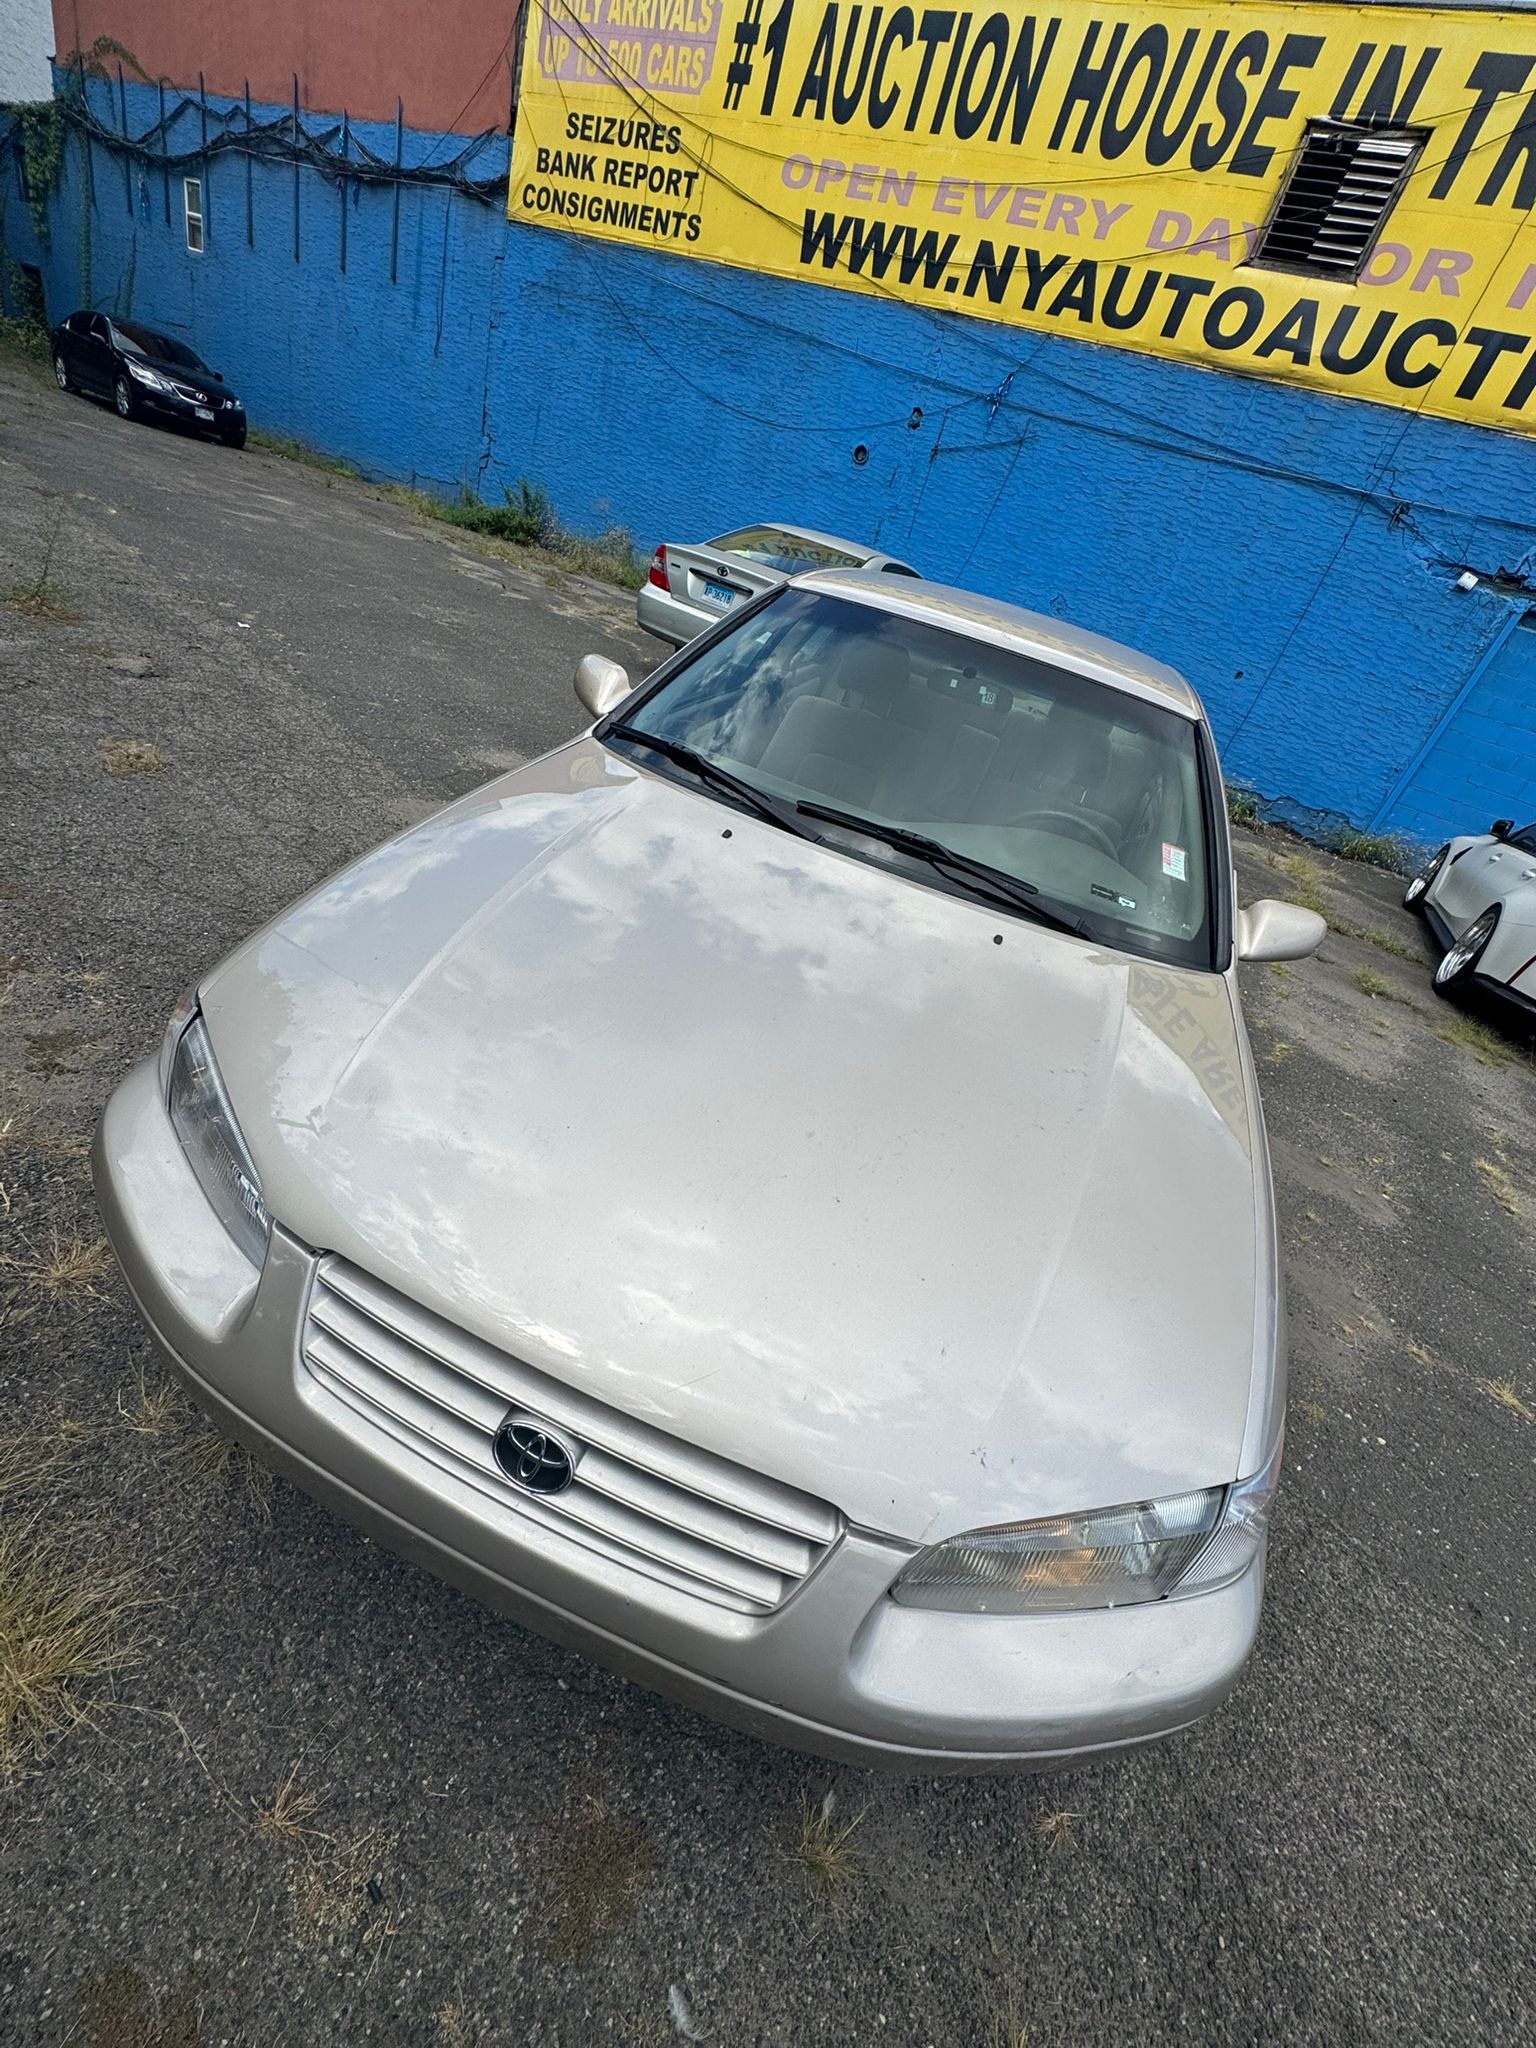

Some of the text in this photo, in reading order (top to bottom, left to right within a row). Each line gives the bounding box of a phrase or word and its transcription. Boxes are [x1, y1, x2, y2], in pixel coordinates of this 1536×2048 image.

[606, 0, 716, 34] ARRIVALS
[544, 34, 706, 90] UP TO 500 CARS
[722, 0, 796, 116] #1
[793, 3, 1061, 146] AUCTION
[1047, 20, 1326, 178] HOUSE
[565, 112, 682, 155] SEIZURES
[536, 147, 700, 199] BANK REPORT
[781, 154, 918, 207] OPEN
[932, 176, 1133, 241] EVERY
[522, 183, 702, 242] CONSIGNMENTS
